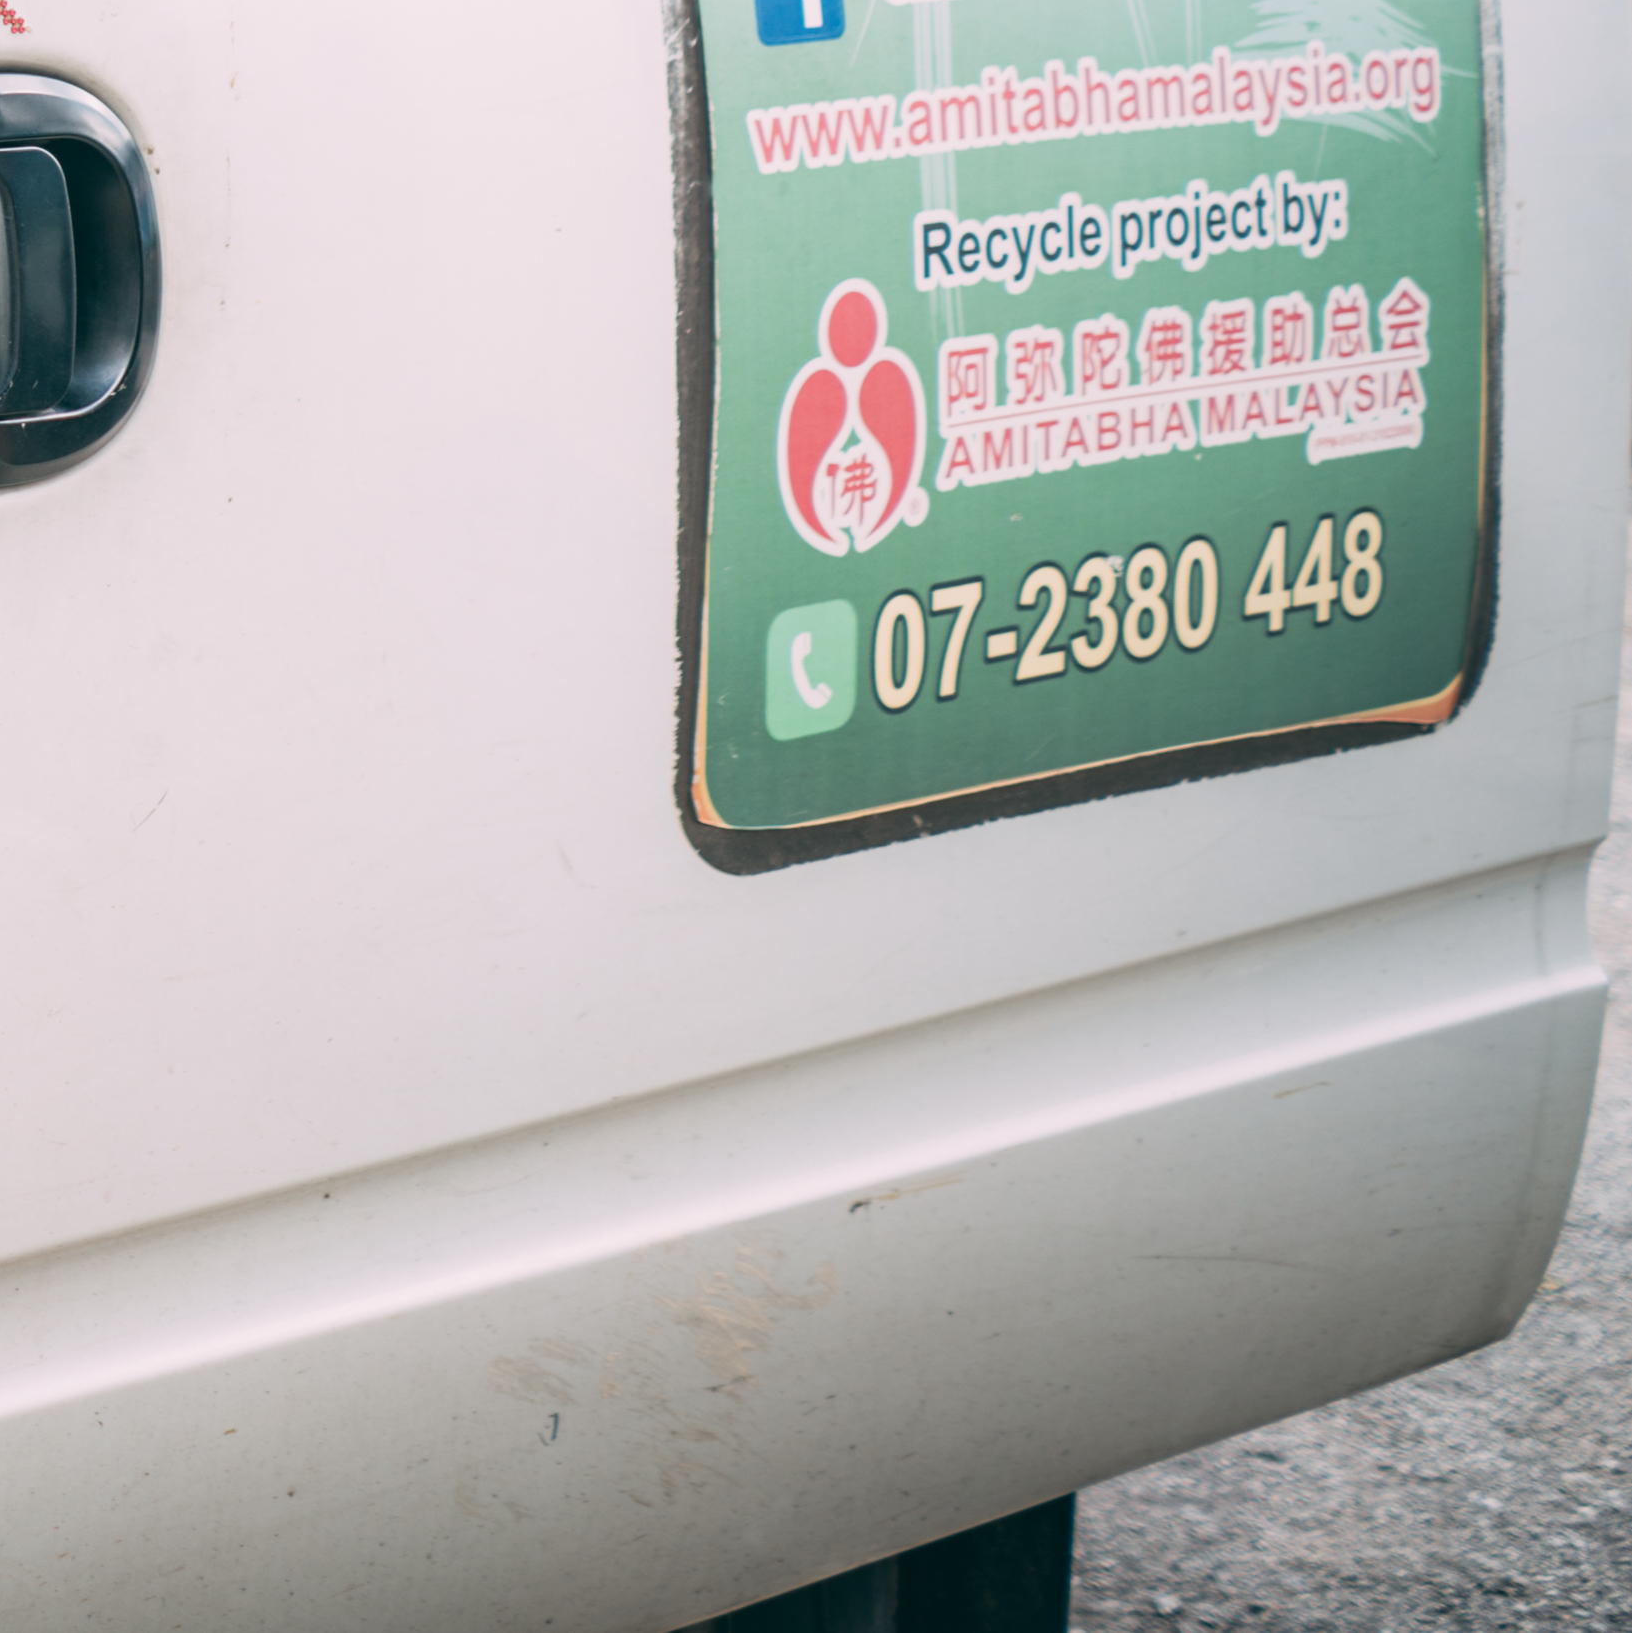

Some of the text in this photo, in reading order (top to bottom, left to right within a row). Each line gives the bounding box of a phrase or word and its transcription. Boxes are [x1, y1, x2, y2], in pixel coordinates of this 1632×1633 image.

[755, 48, 1437, 165] www.amitabhamalaysia.org
[922, 181, 1344, 281] Recycle project by:
[946, 287, 1423, 415] 阿弥陀佛援助总会
[944, 368, 1422, 481] AMITABHA MALAYSIA
[872, 508, 1386, 713] 07-2380 448
